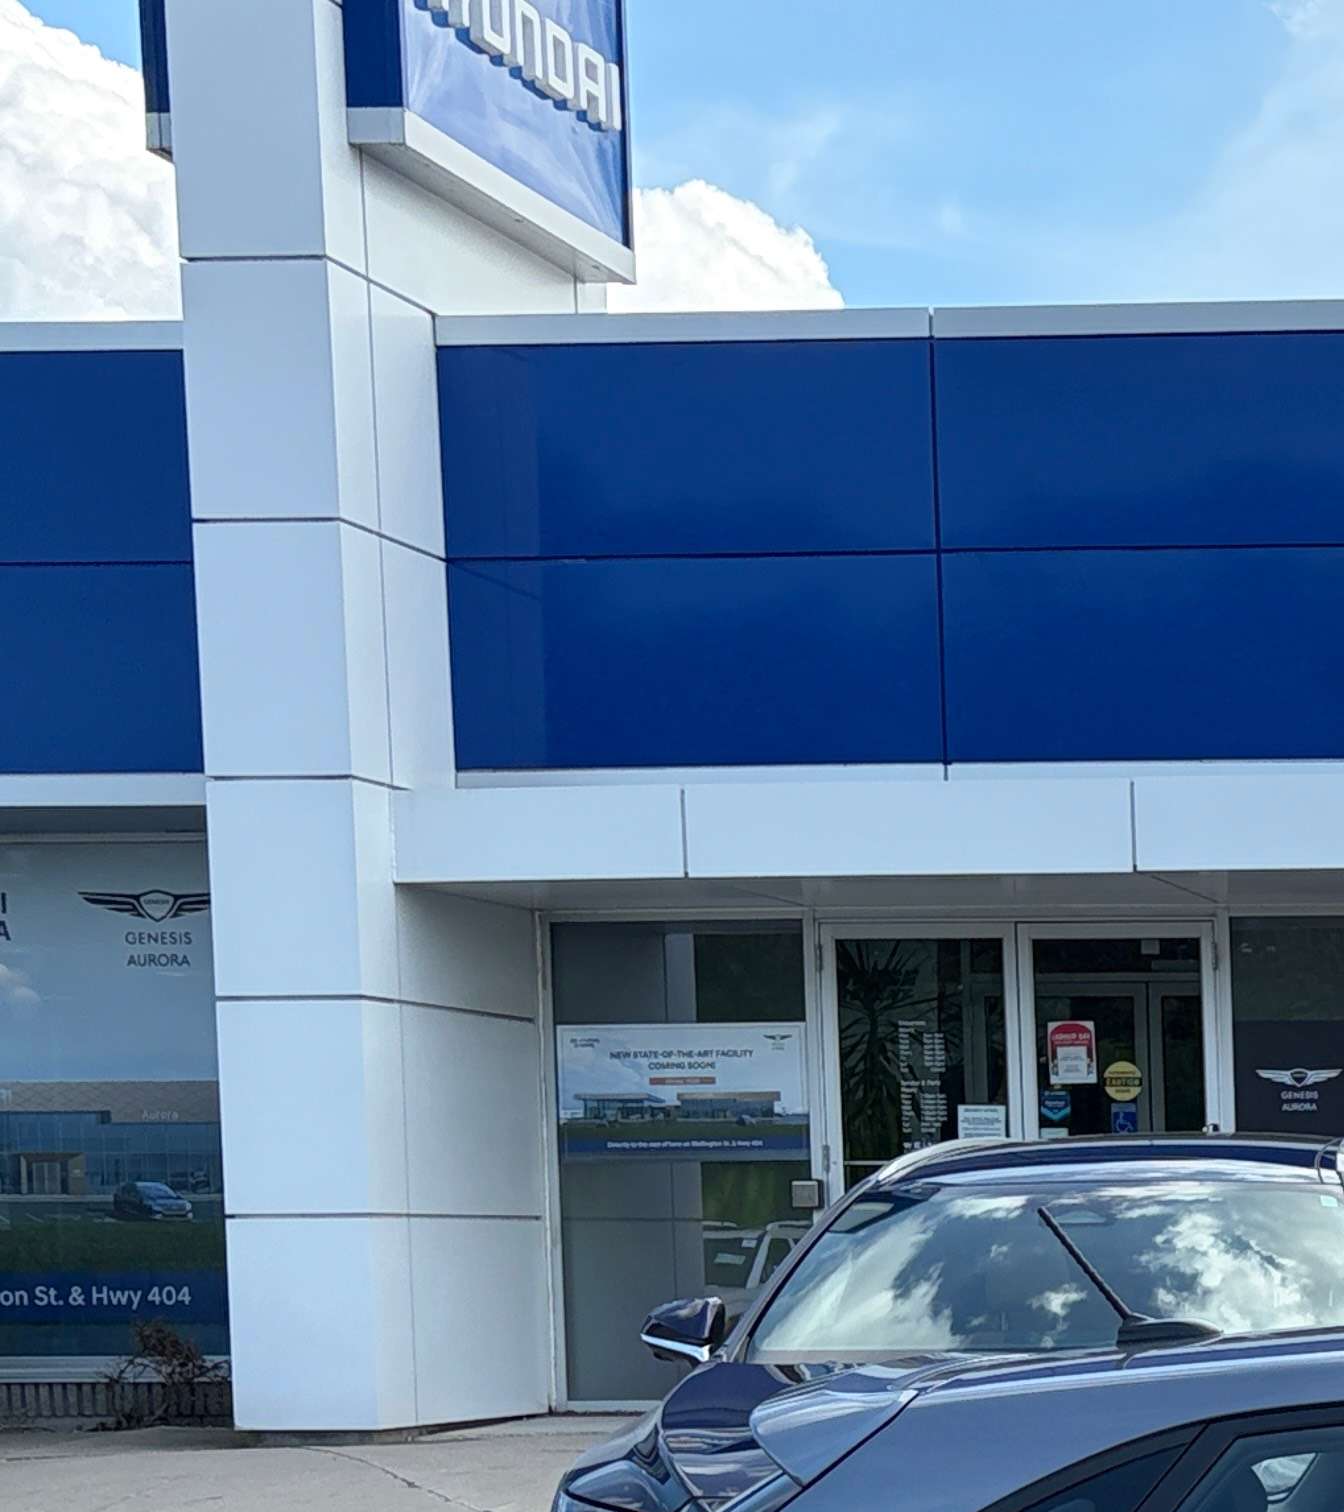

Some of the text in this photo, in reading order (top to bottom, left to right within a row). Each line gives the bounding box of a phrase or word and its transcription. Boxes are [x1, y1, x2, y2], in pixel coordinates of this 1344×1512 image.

[124, 931, 193, 945] GENESIS
[126, 953, 191, 968] AURORA
[1280, 1090, 1319, 1100] GENESIS
[1281, 1102, 1318, 1112] AURORA
[142, 1110, 179, 1121] Aurora
[34, 1285, 64, 1306] St.
[68, 1285, 86, 1306] &
[92, 1285, 142, 1311] Hwy
[147, 1285, 192, 1306] 404
